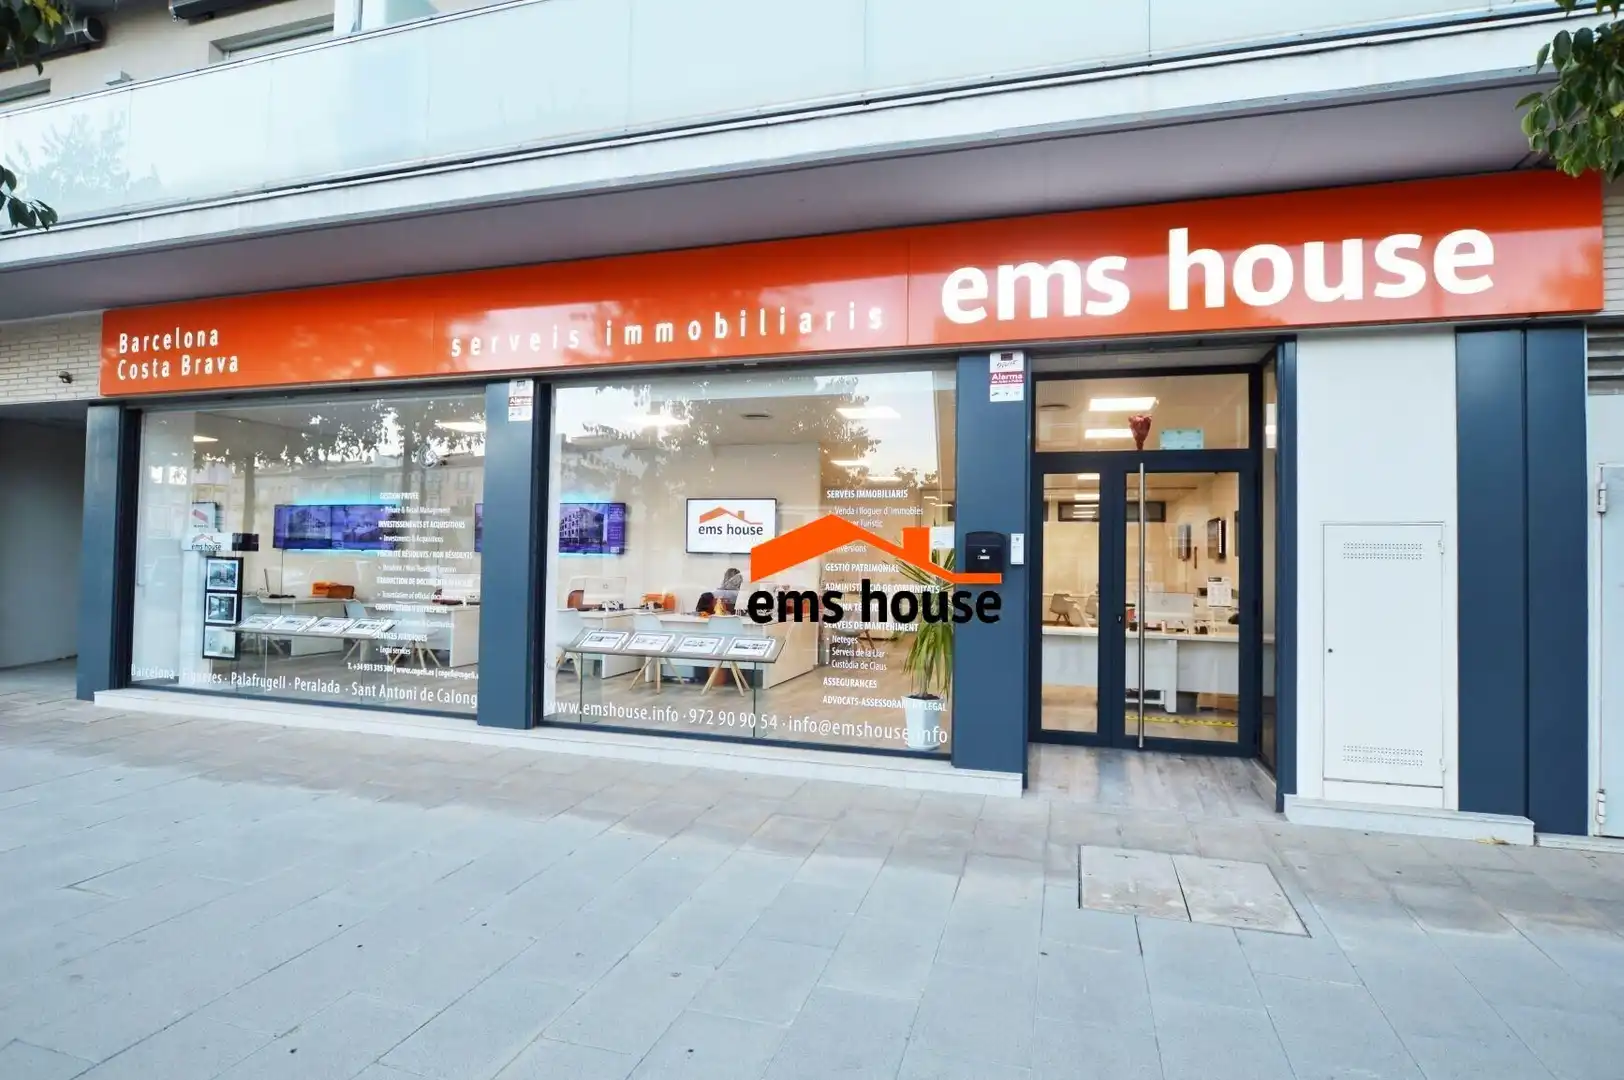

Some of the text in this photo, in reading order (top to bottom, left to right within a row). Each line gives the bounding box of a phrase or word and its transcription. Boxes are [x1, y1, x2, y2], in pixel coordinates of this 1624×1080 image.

[941, 227, 1495, 324] ems house
[450, 301, 883, 358] serveis immobiliaris
[118, 326, 219, 354] Barcelona
[117, 354, 238, 381] Costa Brava
[991, 373, 1023, 381] Alarma
[826, 489, 909, 499] SERVEIS IMMOBILIARIS
[835, 506, 855, 515] Venda
[860, 506, 882, 517] lloguer
[698, 523, 764, 536] ems house
[204, 542, 222, 551] house
[837, 544, 867, 553] versions
[825, 561, 900, 573] GESTIÓ PATRIMONIAL
[825, 583, 881, 592] ADMINISTCIÓ
[864, 621, 919, 632] MANTENIMENT
[832, 635, 858, 646] Neteges
[832, 647, 855, 657] Serveis
[856, 648, 865, 657] de
[831, 659, 888, 671] Custòdia de Claus
[131, 663, 175, 680] Barcelona
[231, 671, 286, 691] Palafrugell
[294, 677, 340, 694] Peralada
[351, 681, 377, 697] Sant
[379, 684, 417, 700] Antoni
[420, 687, 435, 702] de
[437, 688, 478, 708] Calong
[823, 677, 877, 688] ASSEGURANCES
[925, 701, 948, 712] LEGAL
[546, 700, 948, 744] www.emshouse.info 972 90 90 54 info@emshouseinfo
